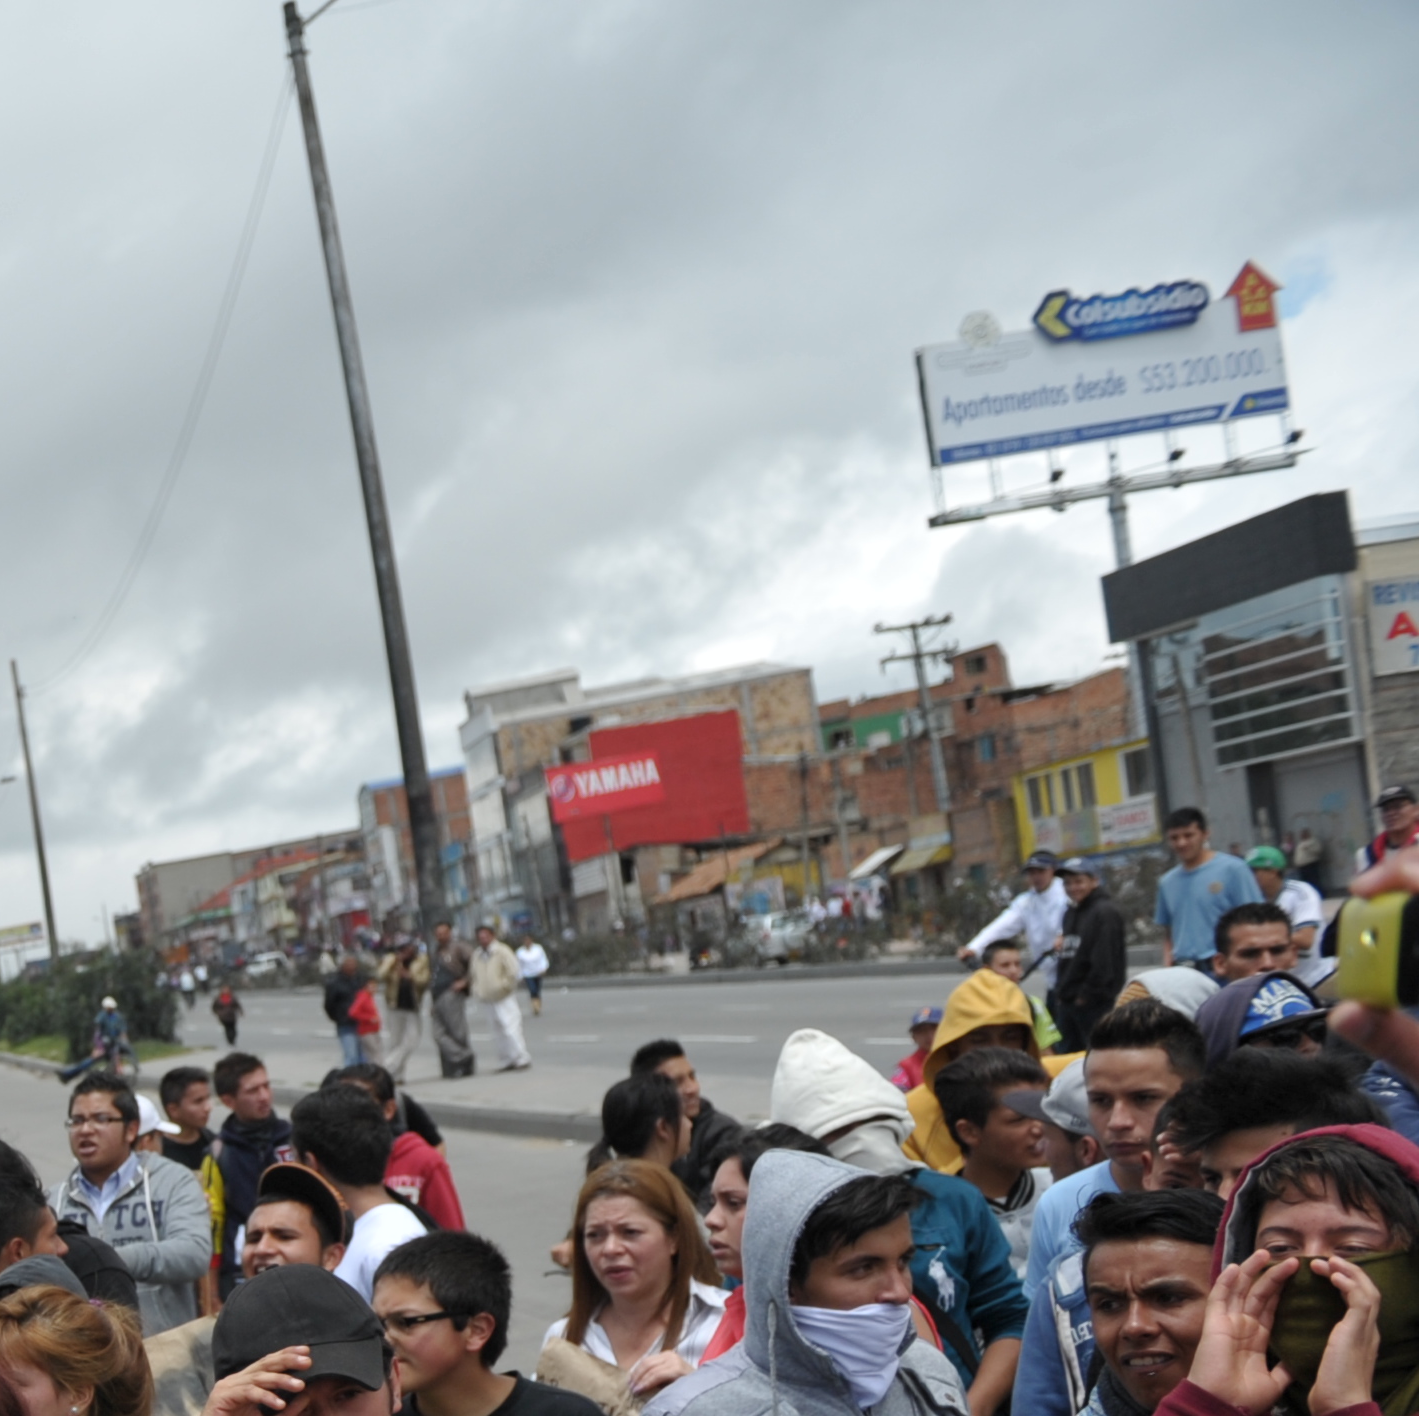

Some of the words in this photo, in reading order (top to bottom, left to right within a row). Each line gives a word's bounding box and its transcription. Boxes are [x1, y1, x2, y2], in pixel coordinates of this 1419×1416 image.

[1066, 284, 1206, 327] Colsubsidio
[942, 383, 1069, 427] Apartamentos
[1074, 372, 1126, 402] desde
[574, 758, 661, 798] YAMAHA
